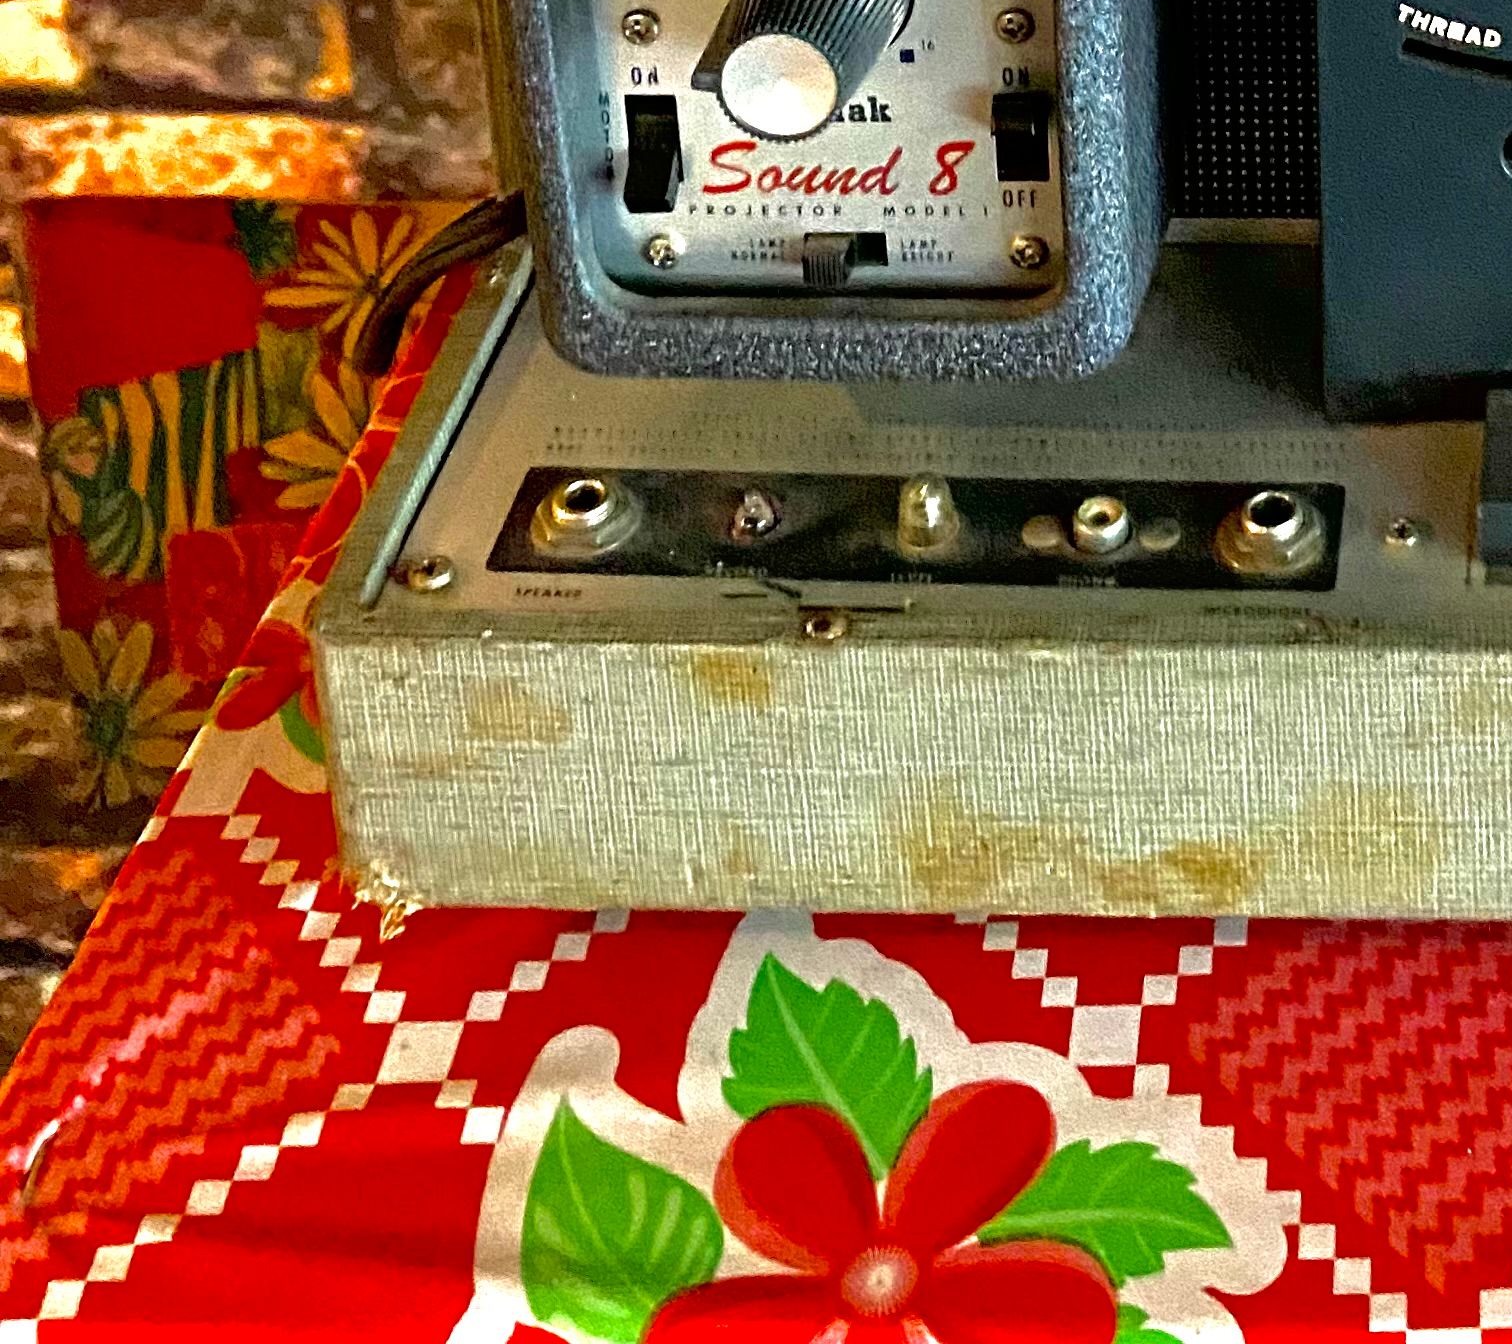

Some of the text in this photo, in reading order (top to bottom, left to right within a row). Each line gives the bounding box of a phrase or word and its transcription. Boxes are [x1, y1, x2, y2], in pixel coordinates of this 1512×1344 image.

[1398, 3, 1503, 48] THREAD
[921, 39, 936, 52] 16
[631, 66, 659, 86] ON
[1002, 66, 1031, 87] ON
[703, 139, 977, 197] Sound 8
[1002, 189, 1038, 209] OFF
[688, 204, 842, 218] PROJECTOR
[883, 205, 967, 218] MODEL
